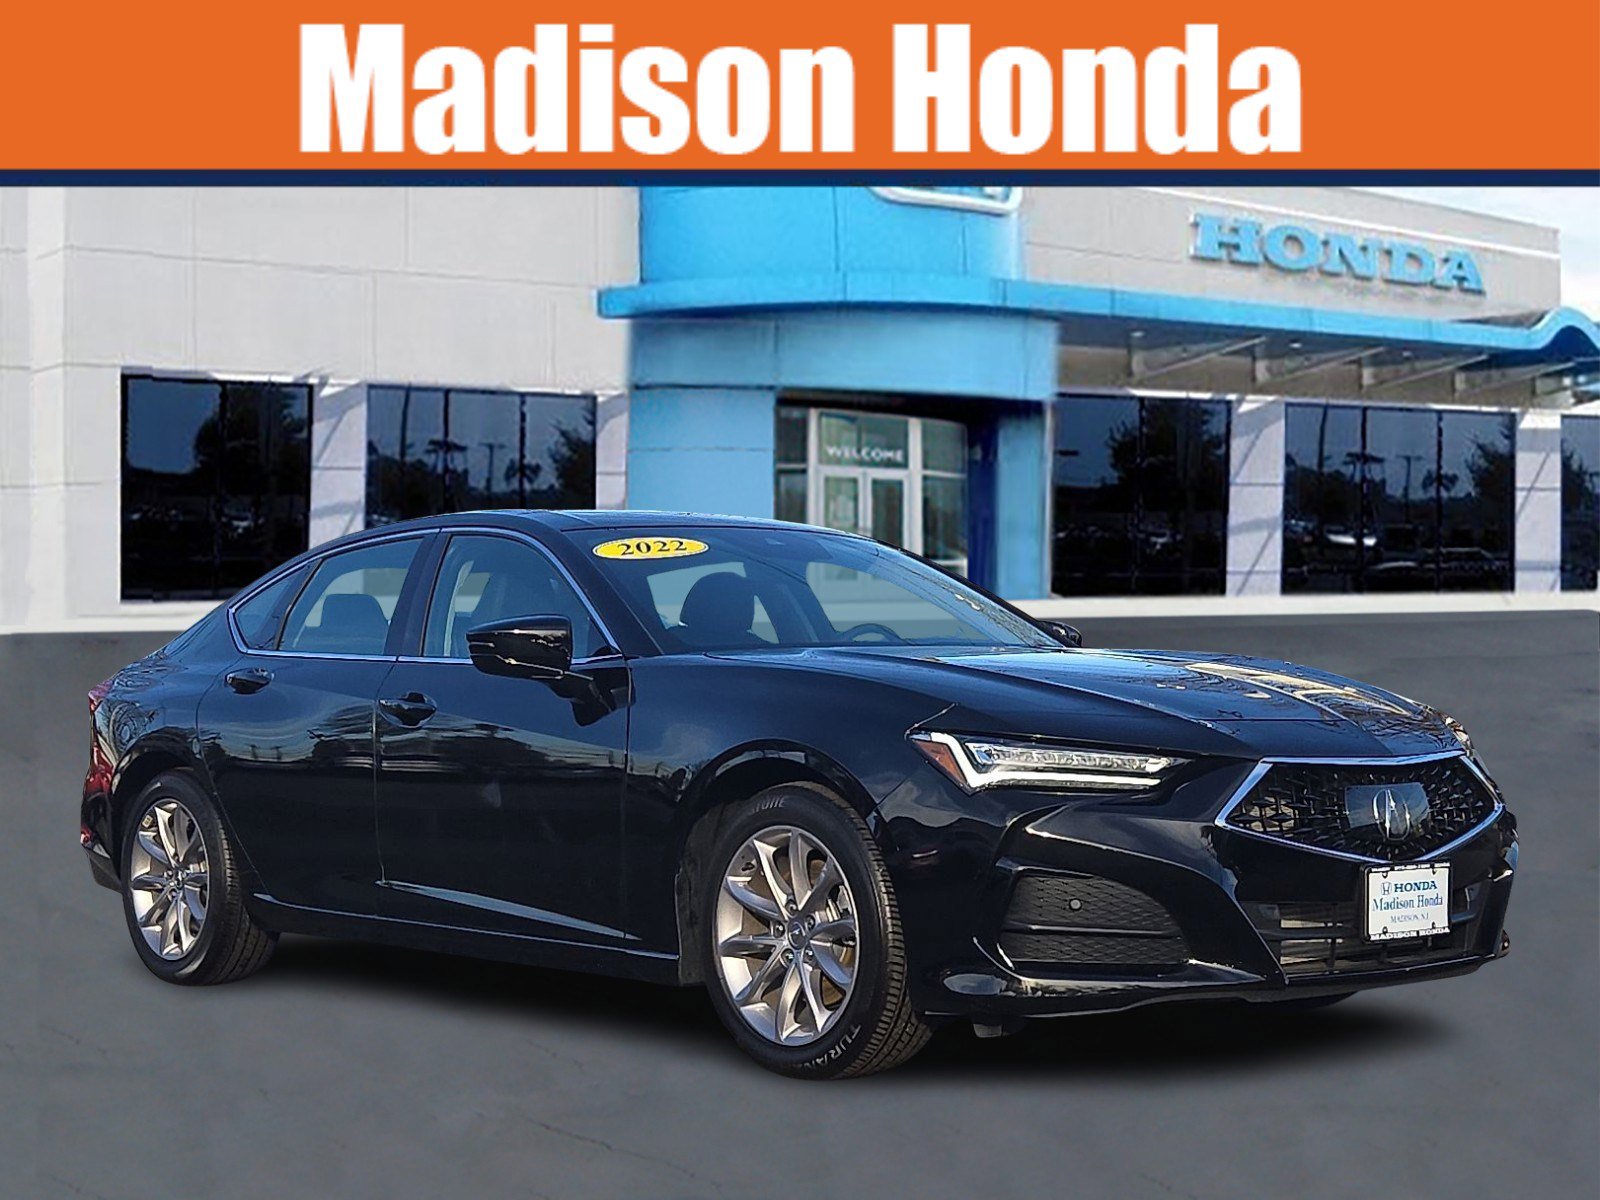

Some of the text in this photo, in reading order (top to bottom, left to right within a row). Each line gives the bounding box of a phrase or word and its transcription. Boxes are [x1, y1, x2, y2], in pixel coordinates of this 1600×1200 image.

[1191, 212, 1486, 295] HONDA
[826, 446, 903, 462] WELCOME
[617, 540, 687, 556] 2022
[1394, 881, 1437, 893] HONDA
[1373, 893, 1443, 911] Madison Honda
